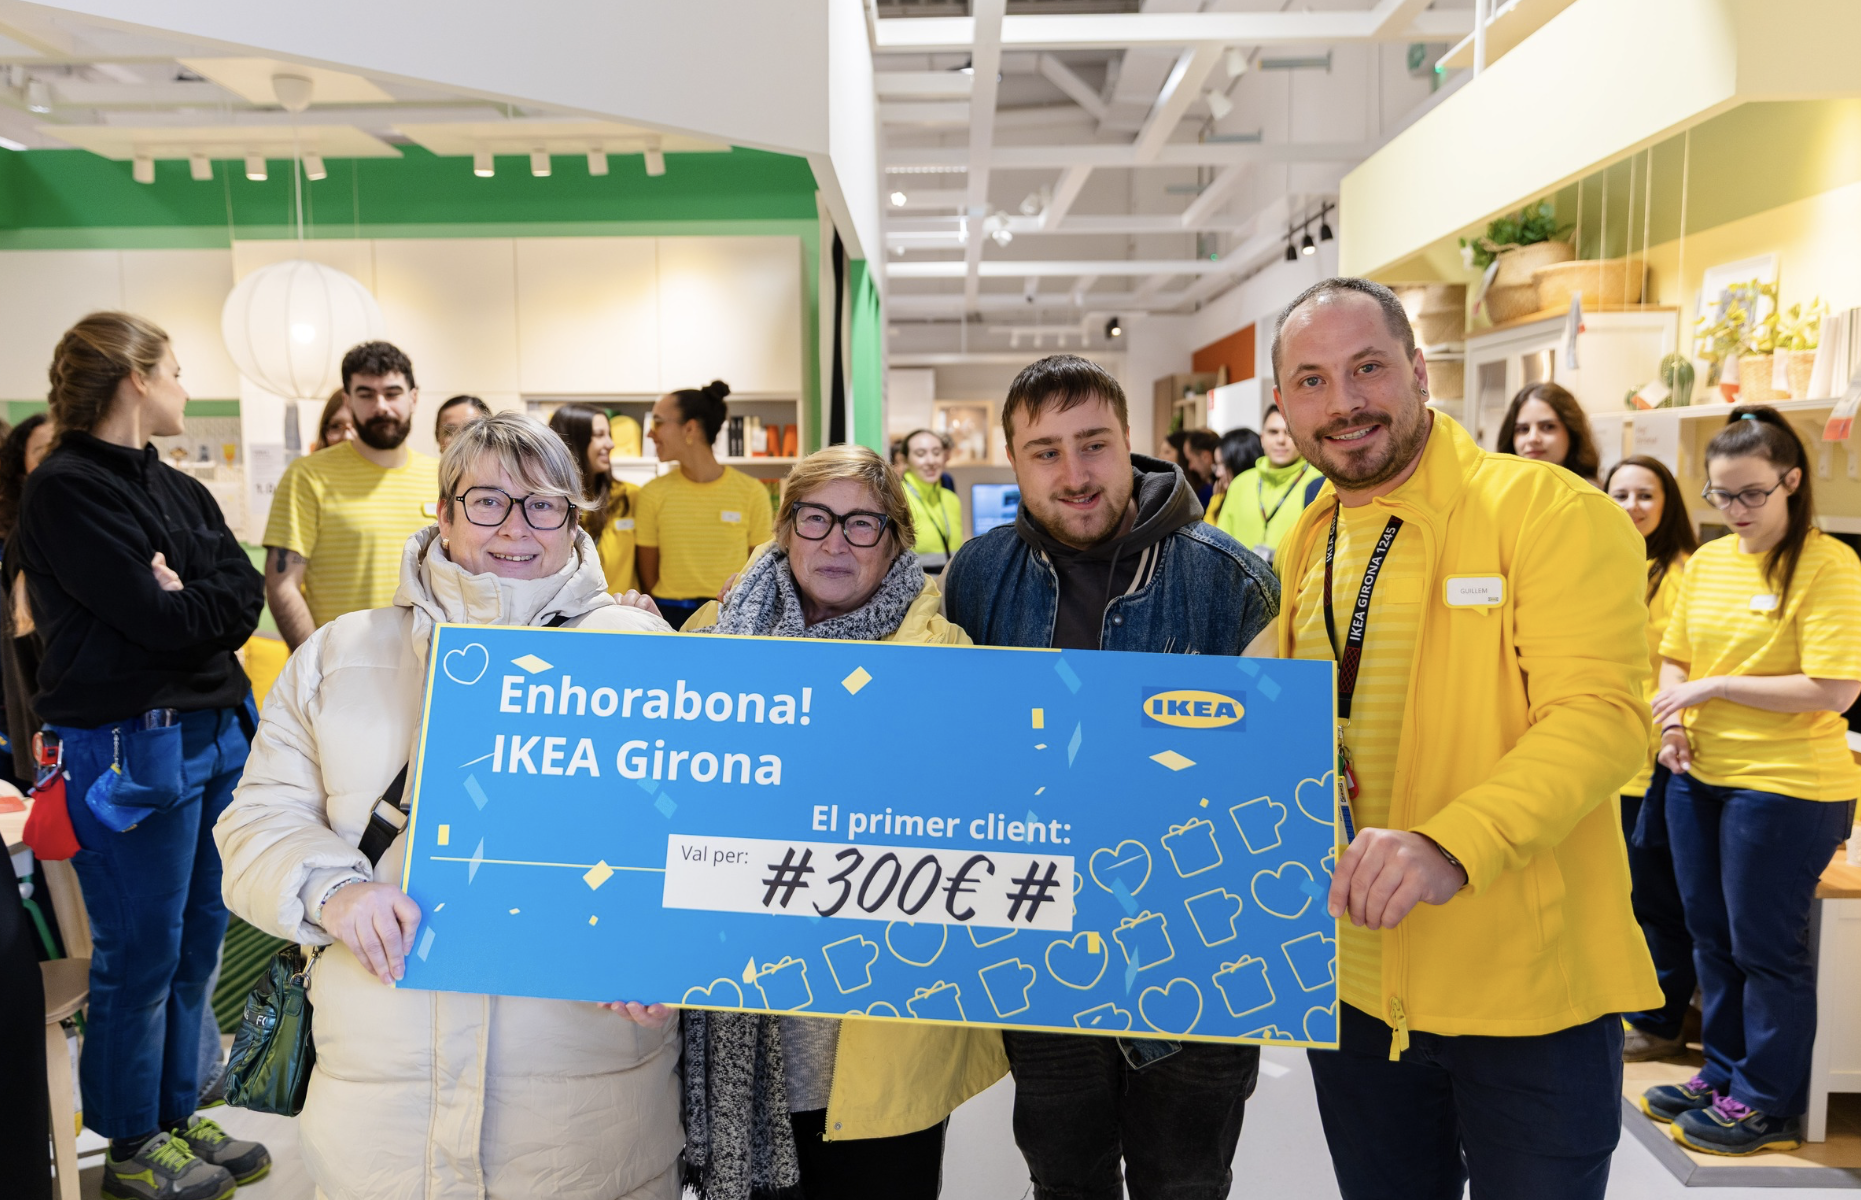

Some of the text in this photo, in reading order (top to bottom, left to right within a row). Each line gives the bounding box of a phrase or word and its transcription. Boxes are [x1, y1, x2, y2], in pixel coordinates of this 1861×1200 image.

[1326, 536, 1334, 563] IKEA
[1349, 526, 1396, 641] IKEA GIRONA 1245
[499, 674, 813, 726] Enhorabona!
[1152, 699, 1237, 719] IKEA
[492, 734, 783, 786] IKEA Girona
[812, 805, 1071, 844] El primer client:
[681, 845, 749, 867] Val per:
[1005, 860, 1061, 923] #
